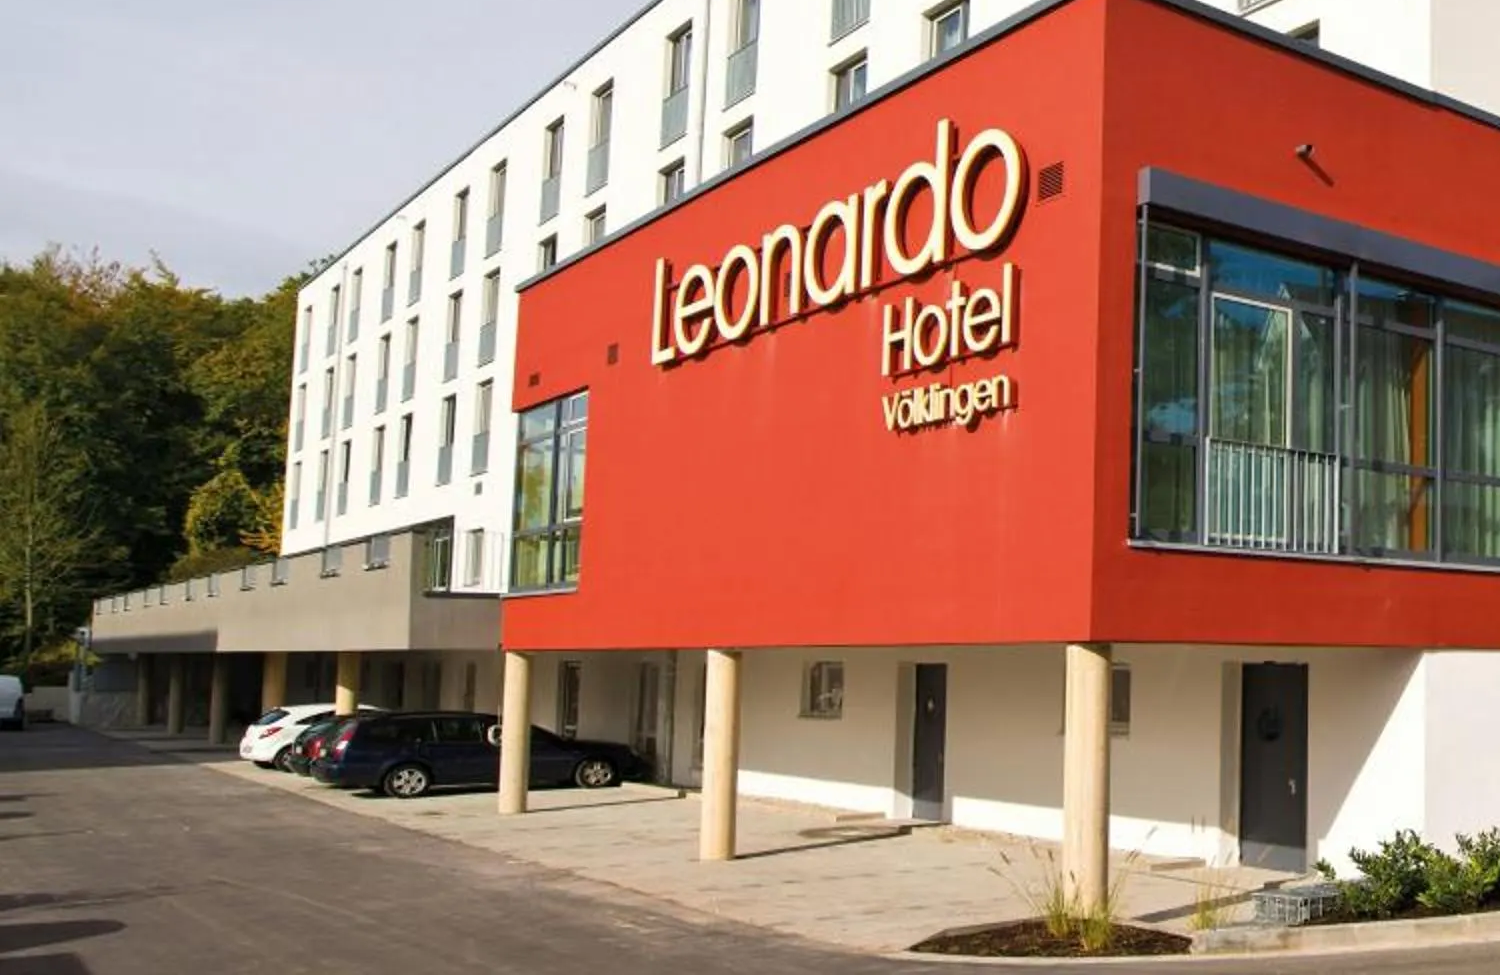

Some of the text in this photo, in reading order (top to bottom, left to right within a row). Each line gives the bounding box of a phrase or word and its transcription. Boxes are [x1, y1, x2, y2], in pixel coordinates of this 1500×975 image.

[652, 118, 1024, 366] Leonardo
[881, 262, 1014, 377] Hotel
[881, 374, 1012, 432] Völklingen
